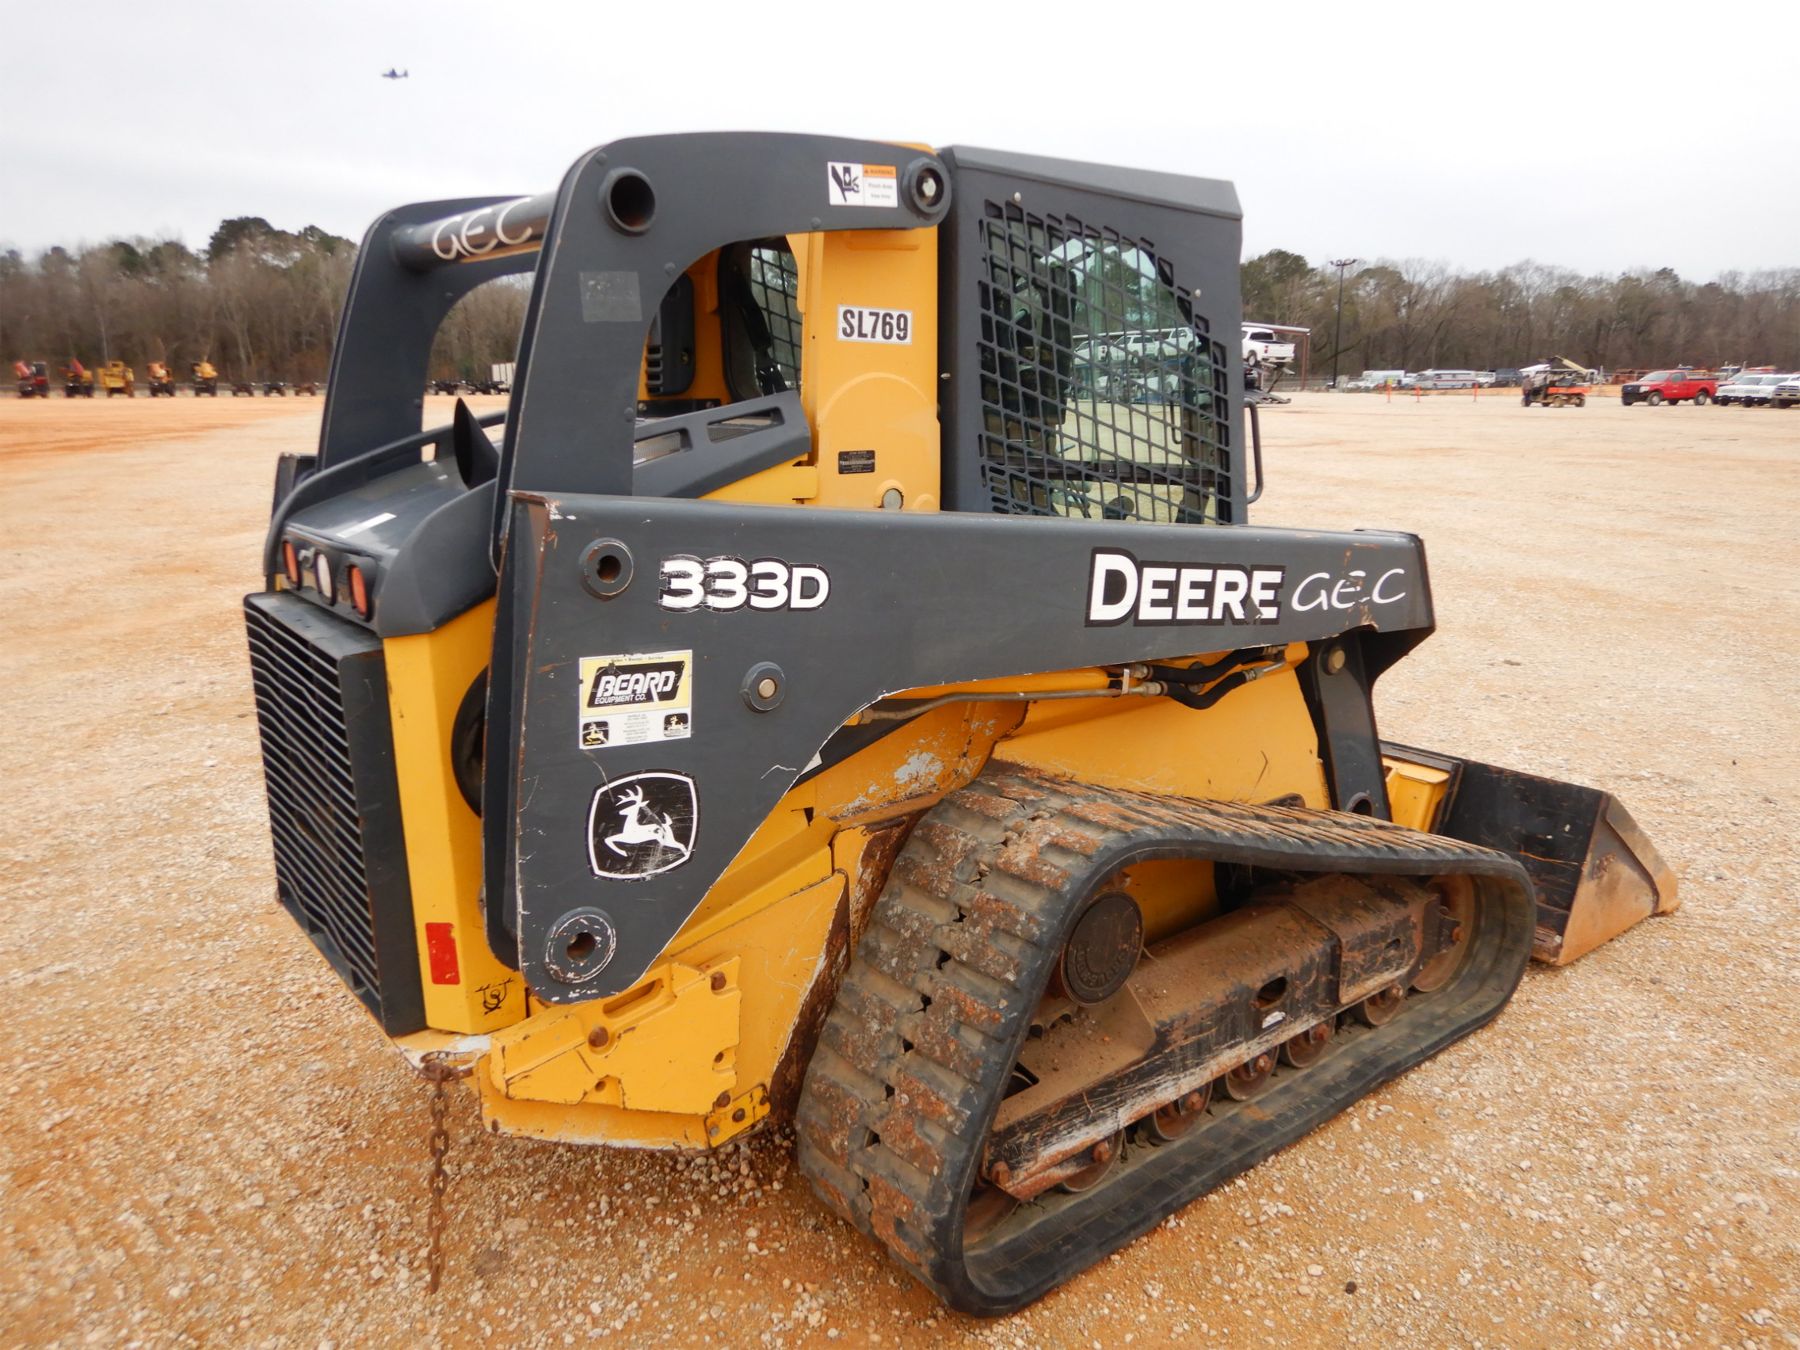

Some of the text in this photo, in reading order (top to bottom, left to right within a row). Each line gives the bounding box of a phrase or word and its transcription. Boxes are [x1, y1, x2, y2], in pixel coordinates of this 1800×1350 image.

[432, 197, 532, 260] GEC
[842, 309, 908, 341] SL769
[660, 557, 831, 610] 333D
[1089, 552, 1283, 622] DEERE
[1291, 568, 1406, 612] GEC
[594, 694, 634, 704] EQUIPMENT
[596, 671, 676, 702] BEARD
